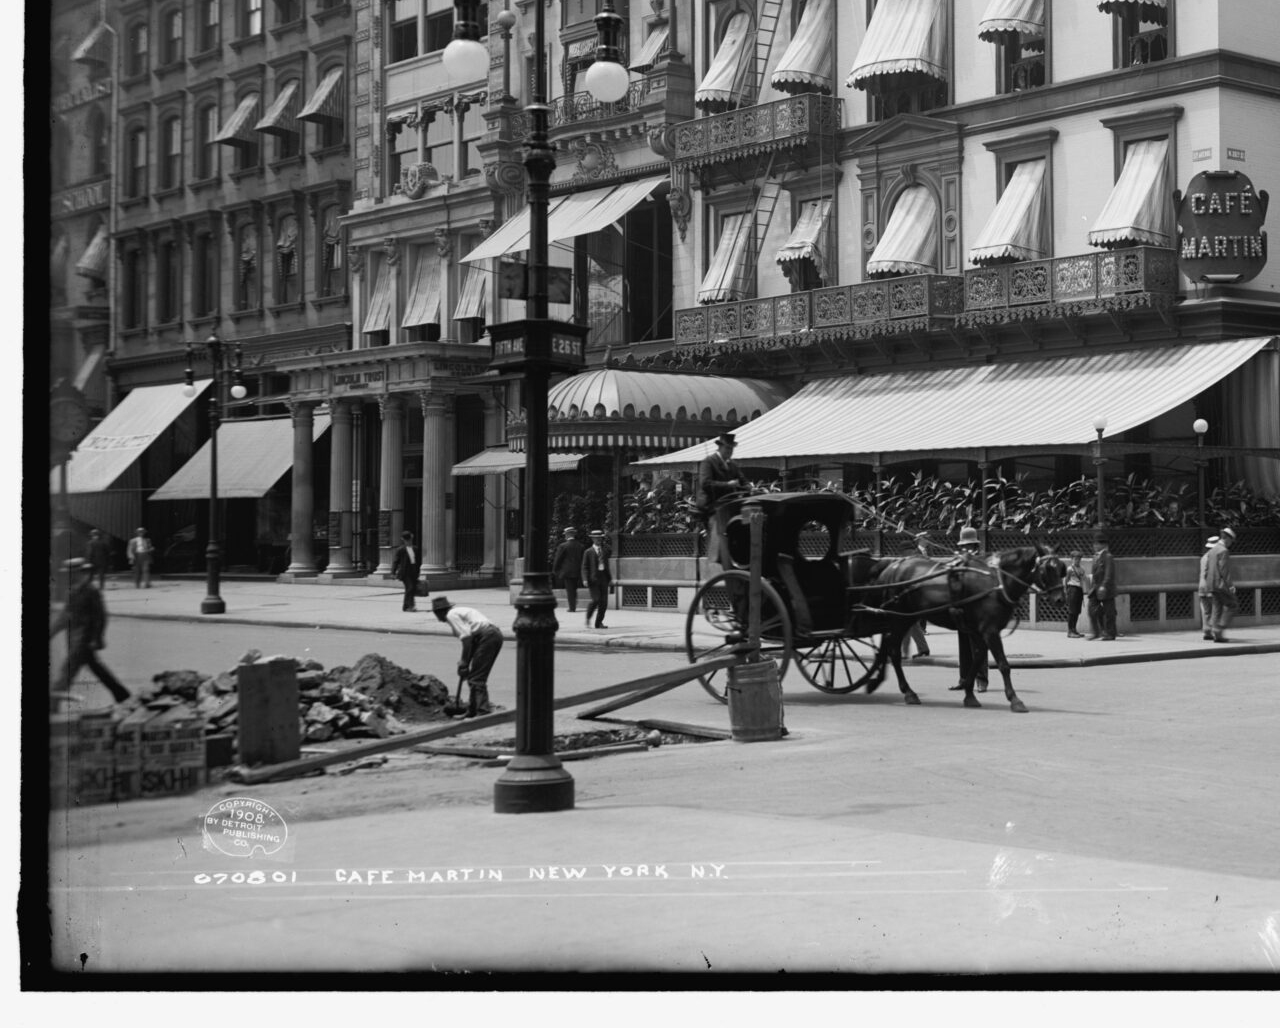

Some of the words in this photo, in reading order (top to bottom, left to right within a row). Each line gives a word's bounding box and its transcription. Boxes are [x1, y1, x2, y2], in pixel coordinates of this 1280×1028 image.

[1191, 184, 1253, 214] CAFÉ
[1181, 235, 1263, 259] MARTIN
[558, 339, 571, 354] 26
[364, 370, 384, 383] TRUST
